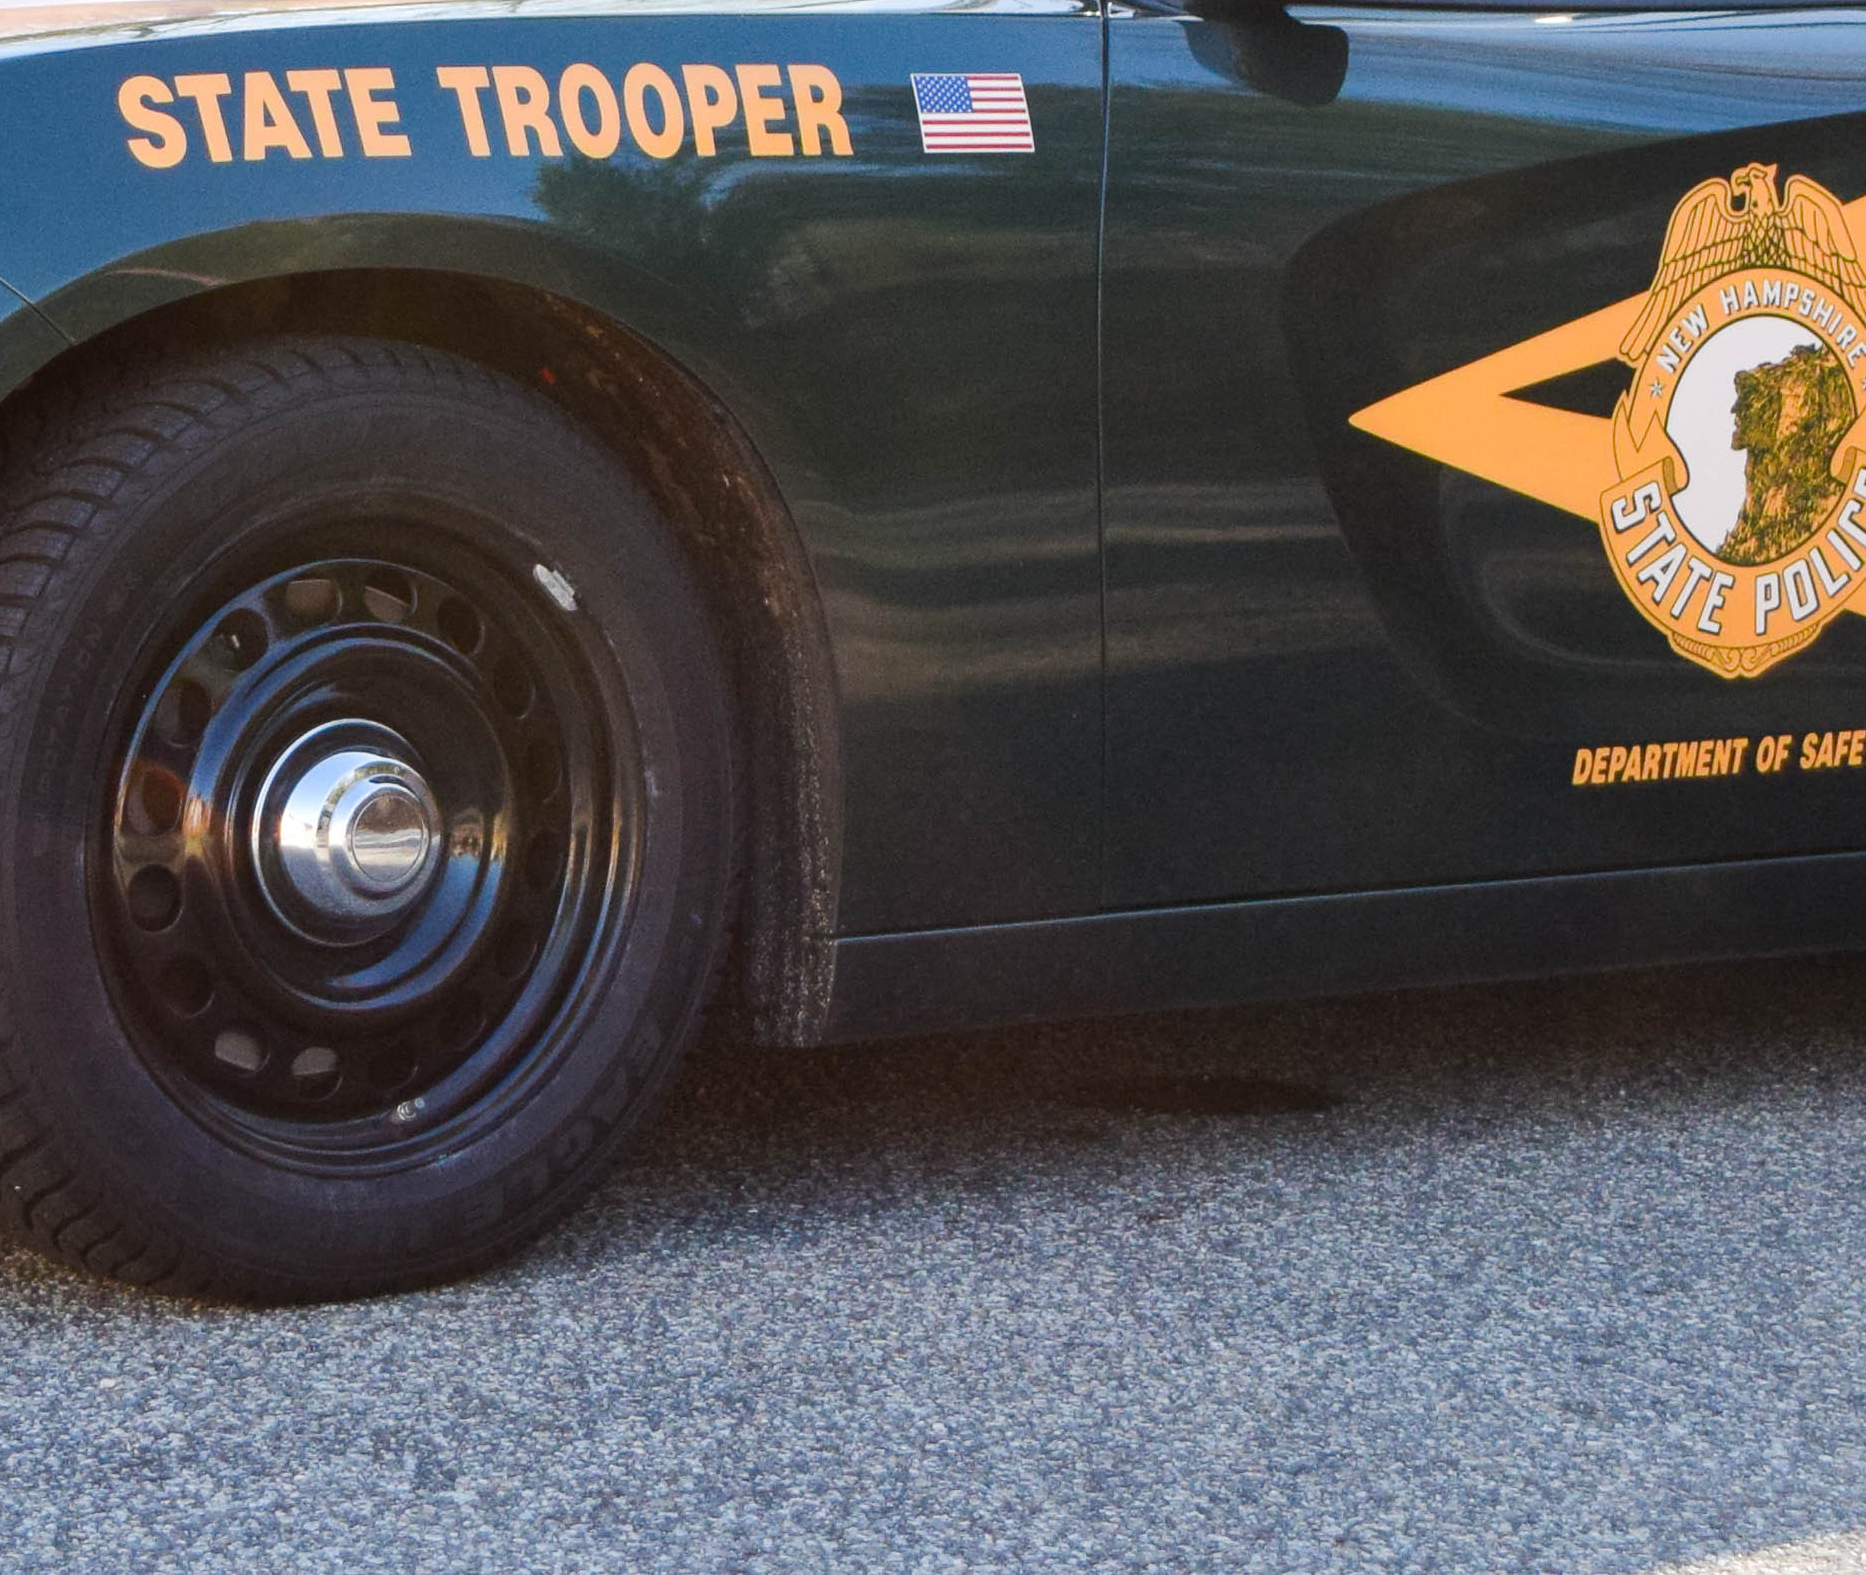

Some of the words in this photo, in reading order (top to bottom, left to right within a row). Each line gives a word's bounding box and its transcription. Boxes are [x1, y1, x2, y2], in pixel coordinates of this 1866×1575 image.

[117, 66, 413, 169] STATE
[437, 62, 854, 160] TROOPER
[1655, 304, 1709, 374] NEW
[1611, 480, 1735, 635] STATE
[1572, 738, 1748, 785] DEPARTMENT
[1756, 734, 1793, 773] OF
